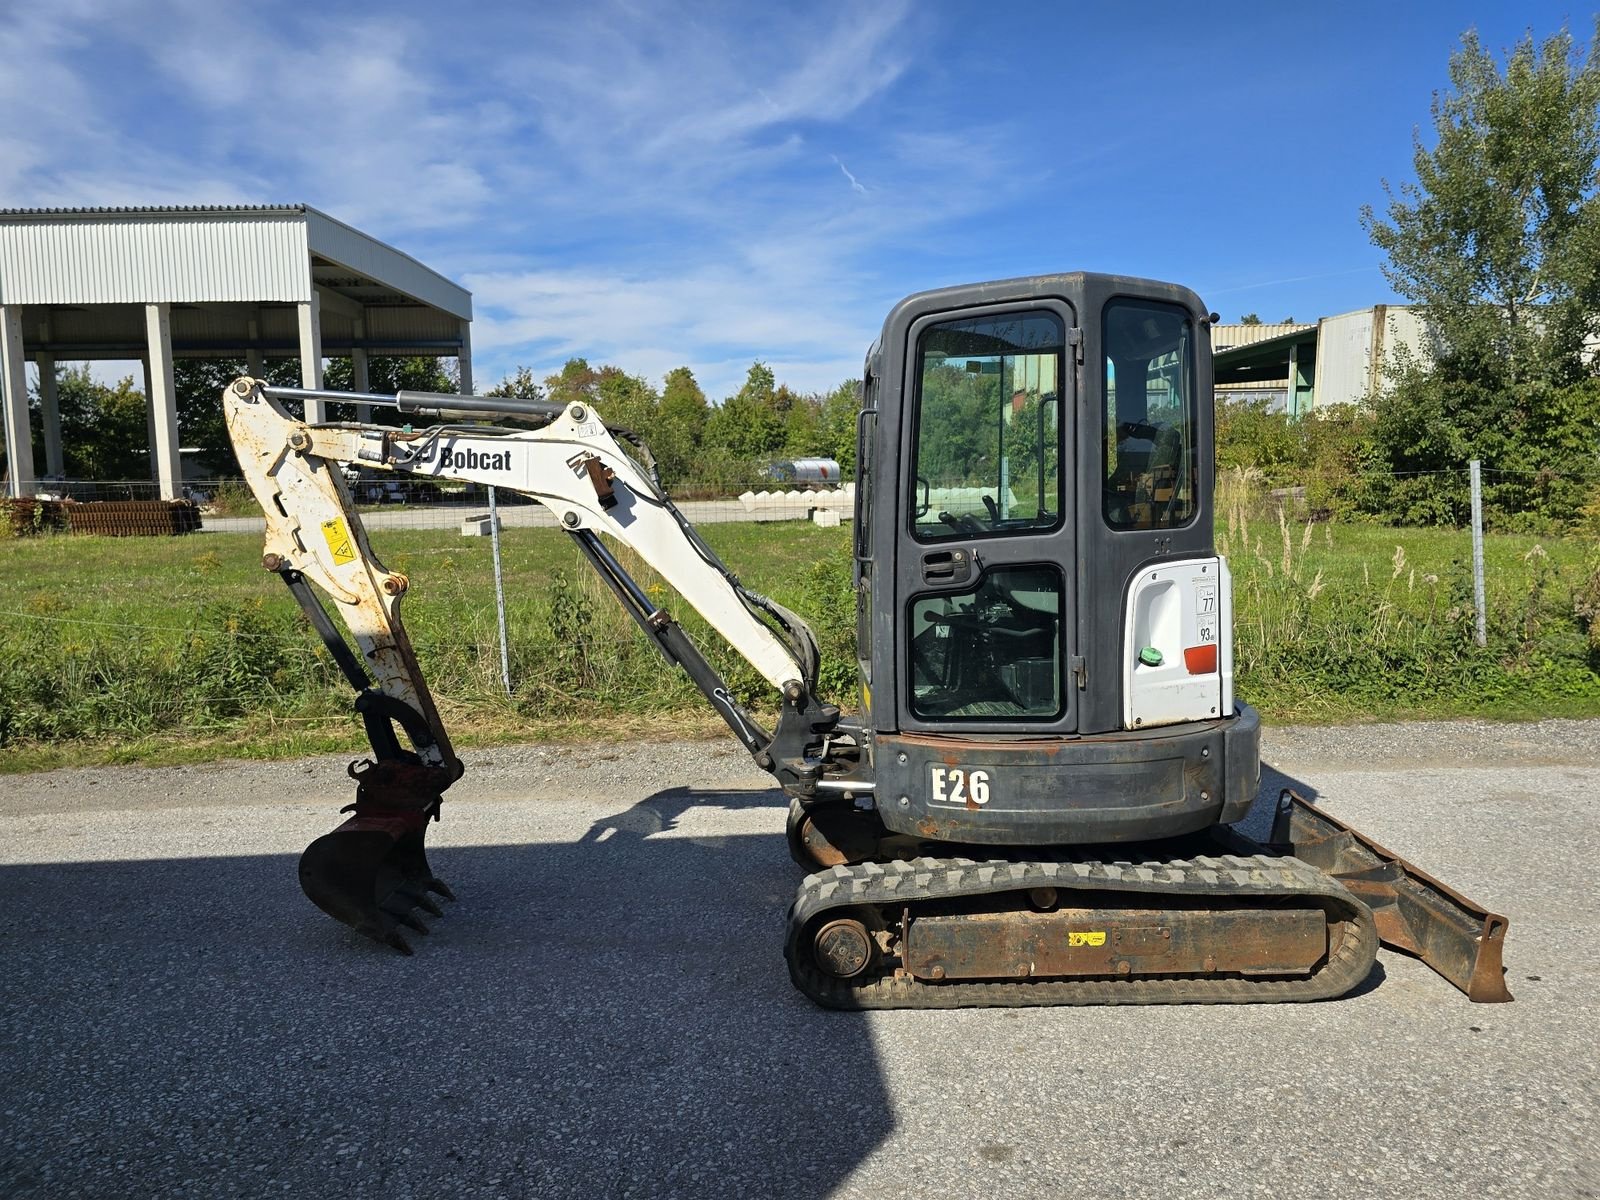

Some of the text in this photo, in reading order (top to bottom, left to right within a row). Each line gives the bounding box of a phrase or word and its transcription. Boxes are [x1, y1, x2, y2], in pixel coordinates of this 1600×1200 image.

[440, 447, 511, 471] Bobcat
[1202, 597, 1214, 612] 77
[1200, 627, 1210, 642] 93
[931, 768, 990, 804] E26
